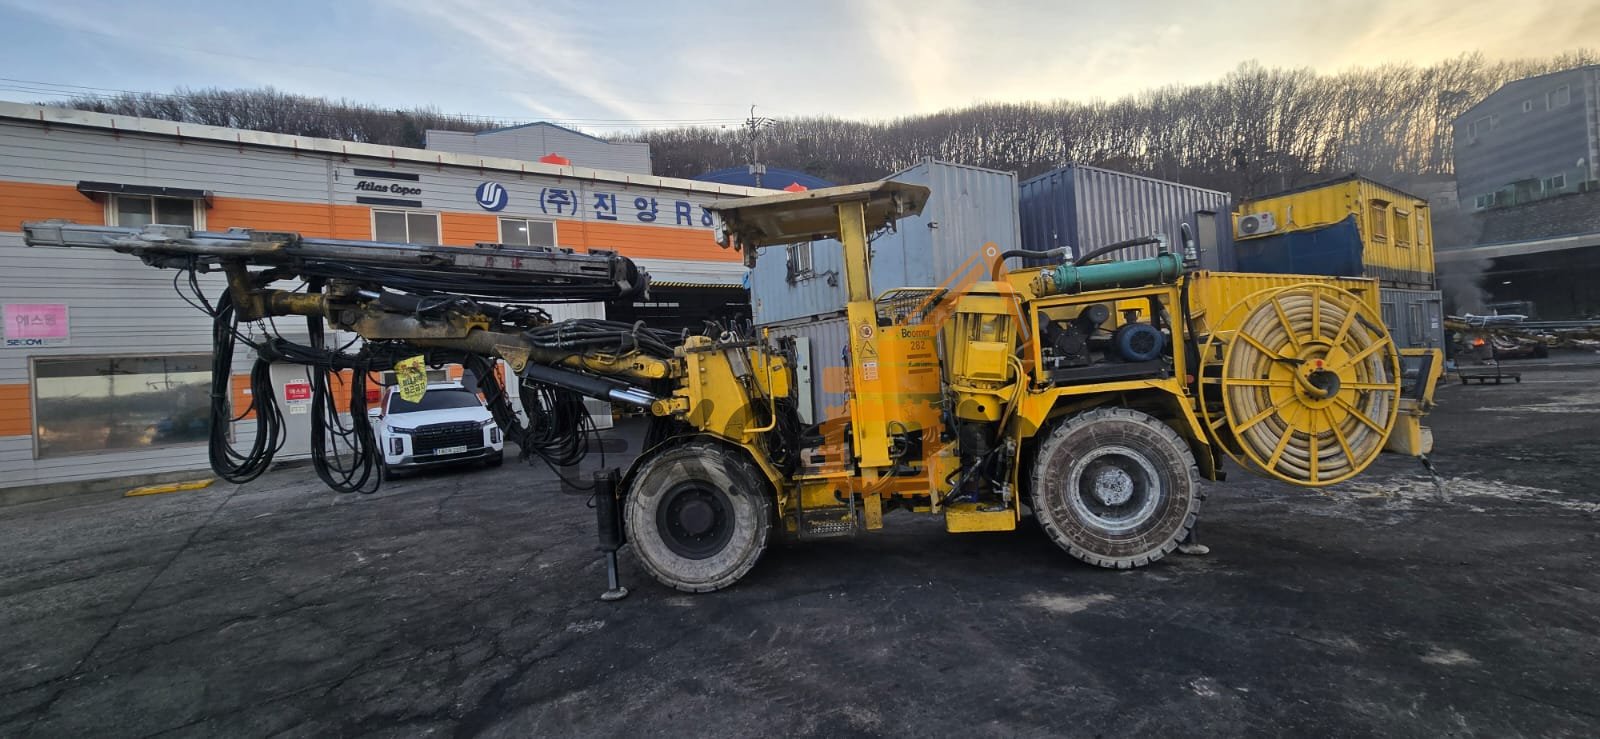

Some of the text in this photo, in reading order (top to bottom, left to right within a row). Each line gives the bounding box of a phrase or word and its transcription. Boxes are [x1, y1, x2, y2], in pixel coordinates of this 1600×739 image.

[355, 181, 422, 195] Atlas Copco
[902, 329, 930, 337] Boomer
[910, 341, 926, 350] 282
